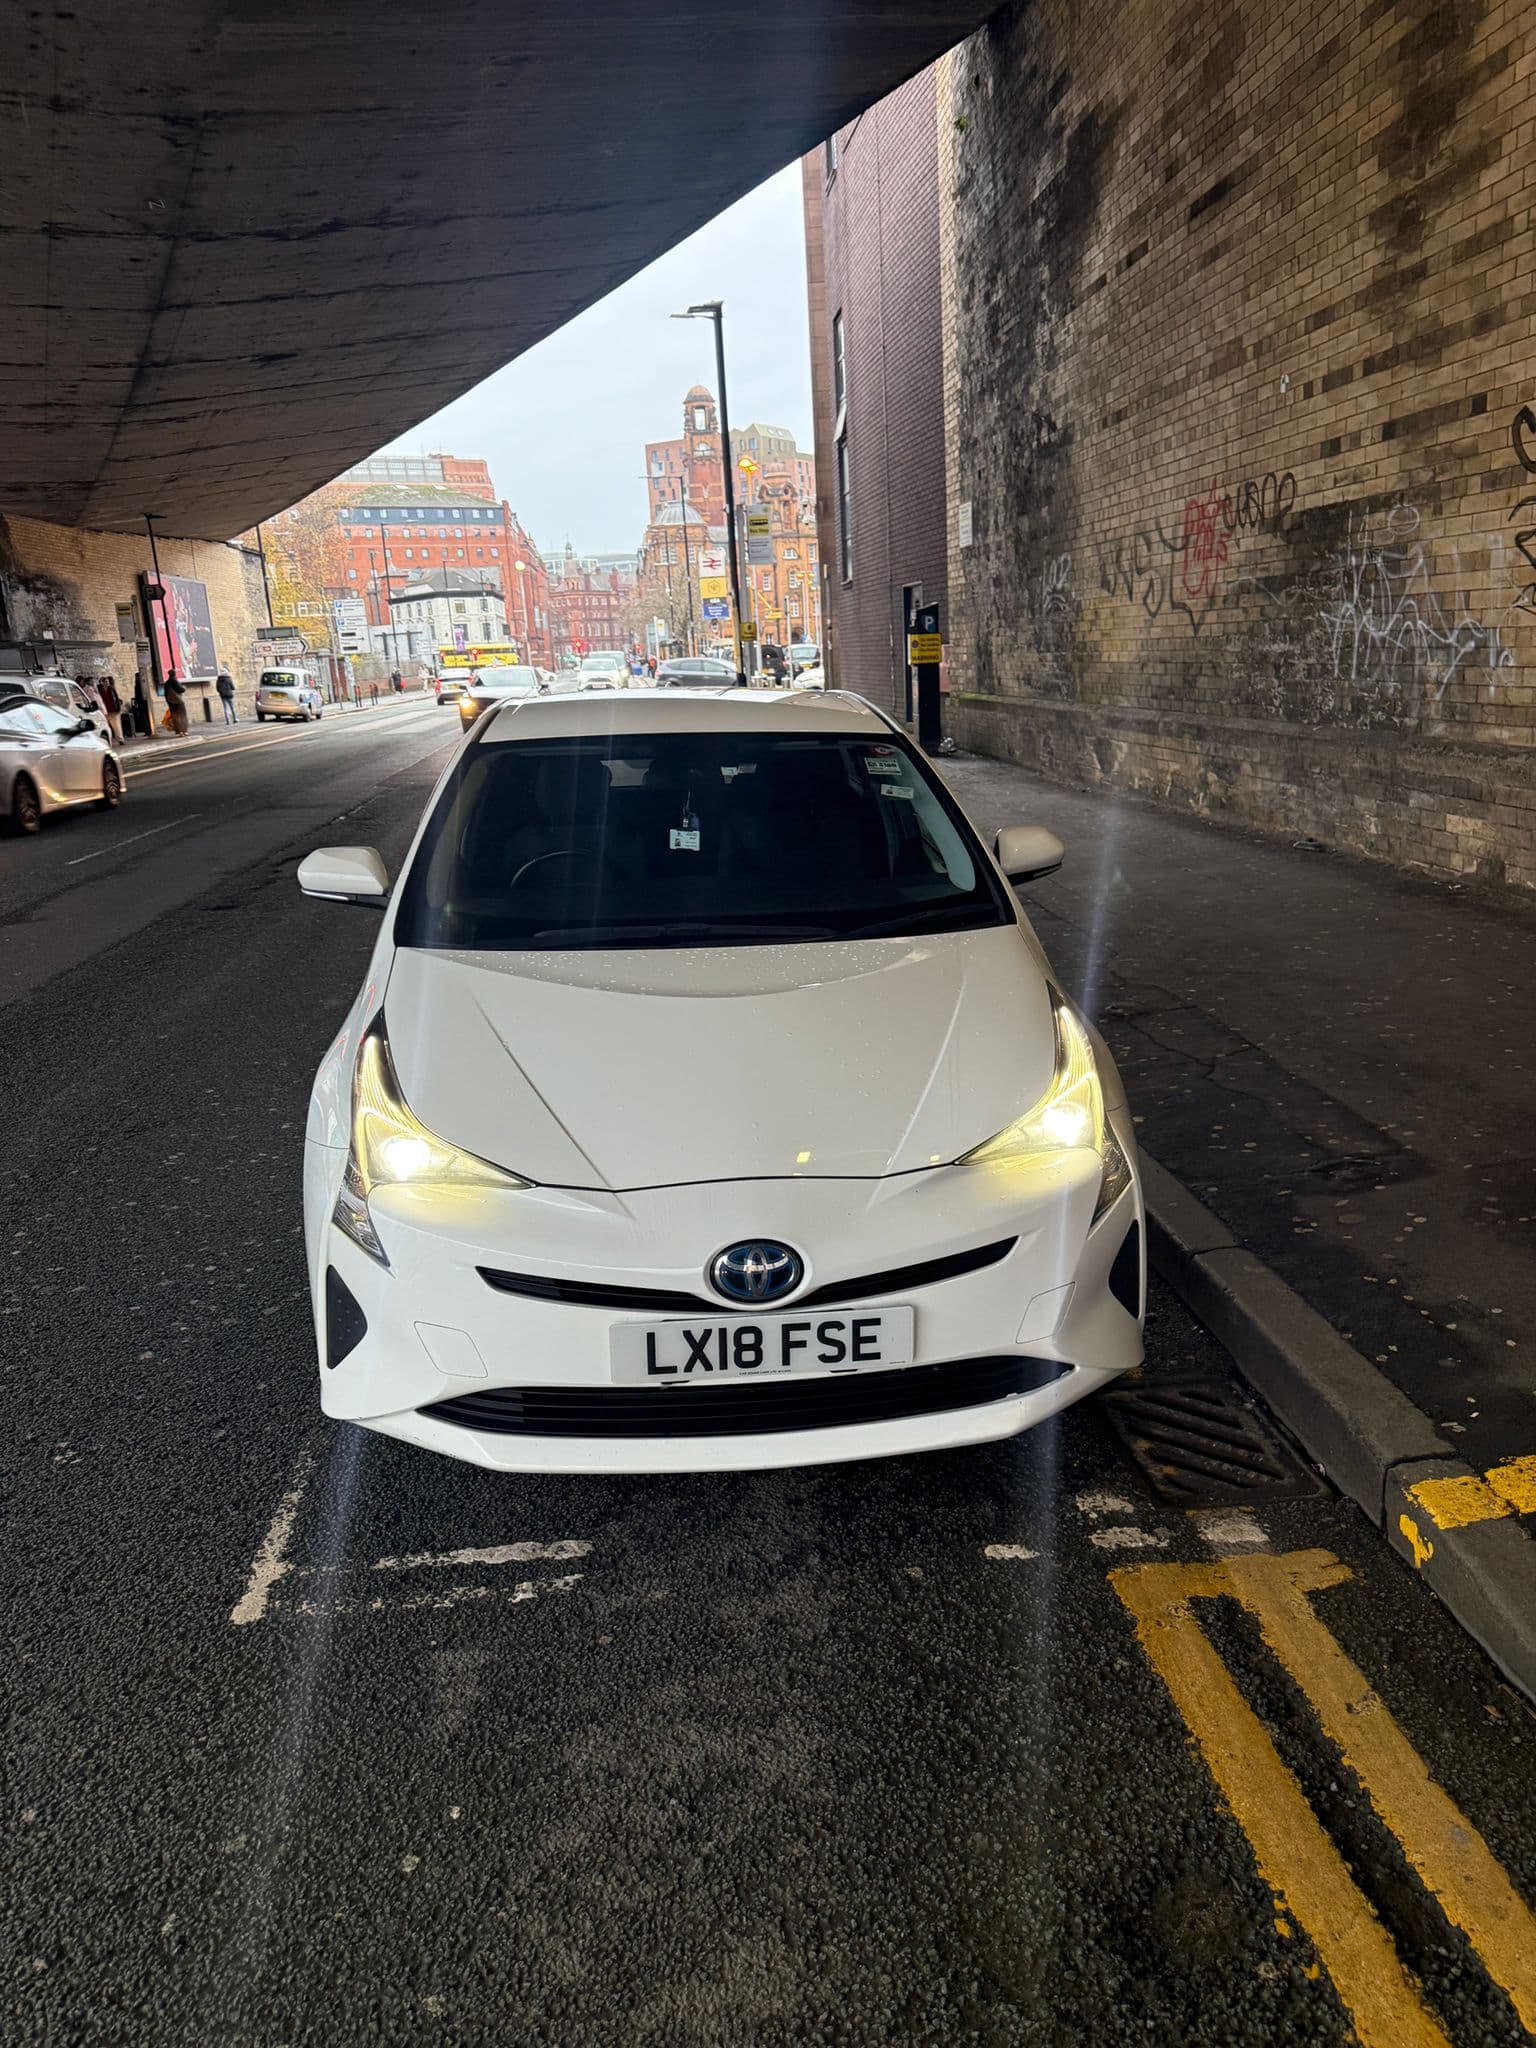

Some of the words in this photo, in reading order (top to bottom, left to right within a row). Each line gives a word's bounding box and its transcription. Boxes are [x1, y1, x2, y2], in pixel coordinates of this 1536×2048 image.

[925, 615, 934, 631] P
[646, 1325, 764, 1376] LX18
[781, 1317, 882, 1367] FSE
